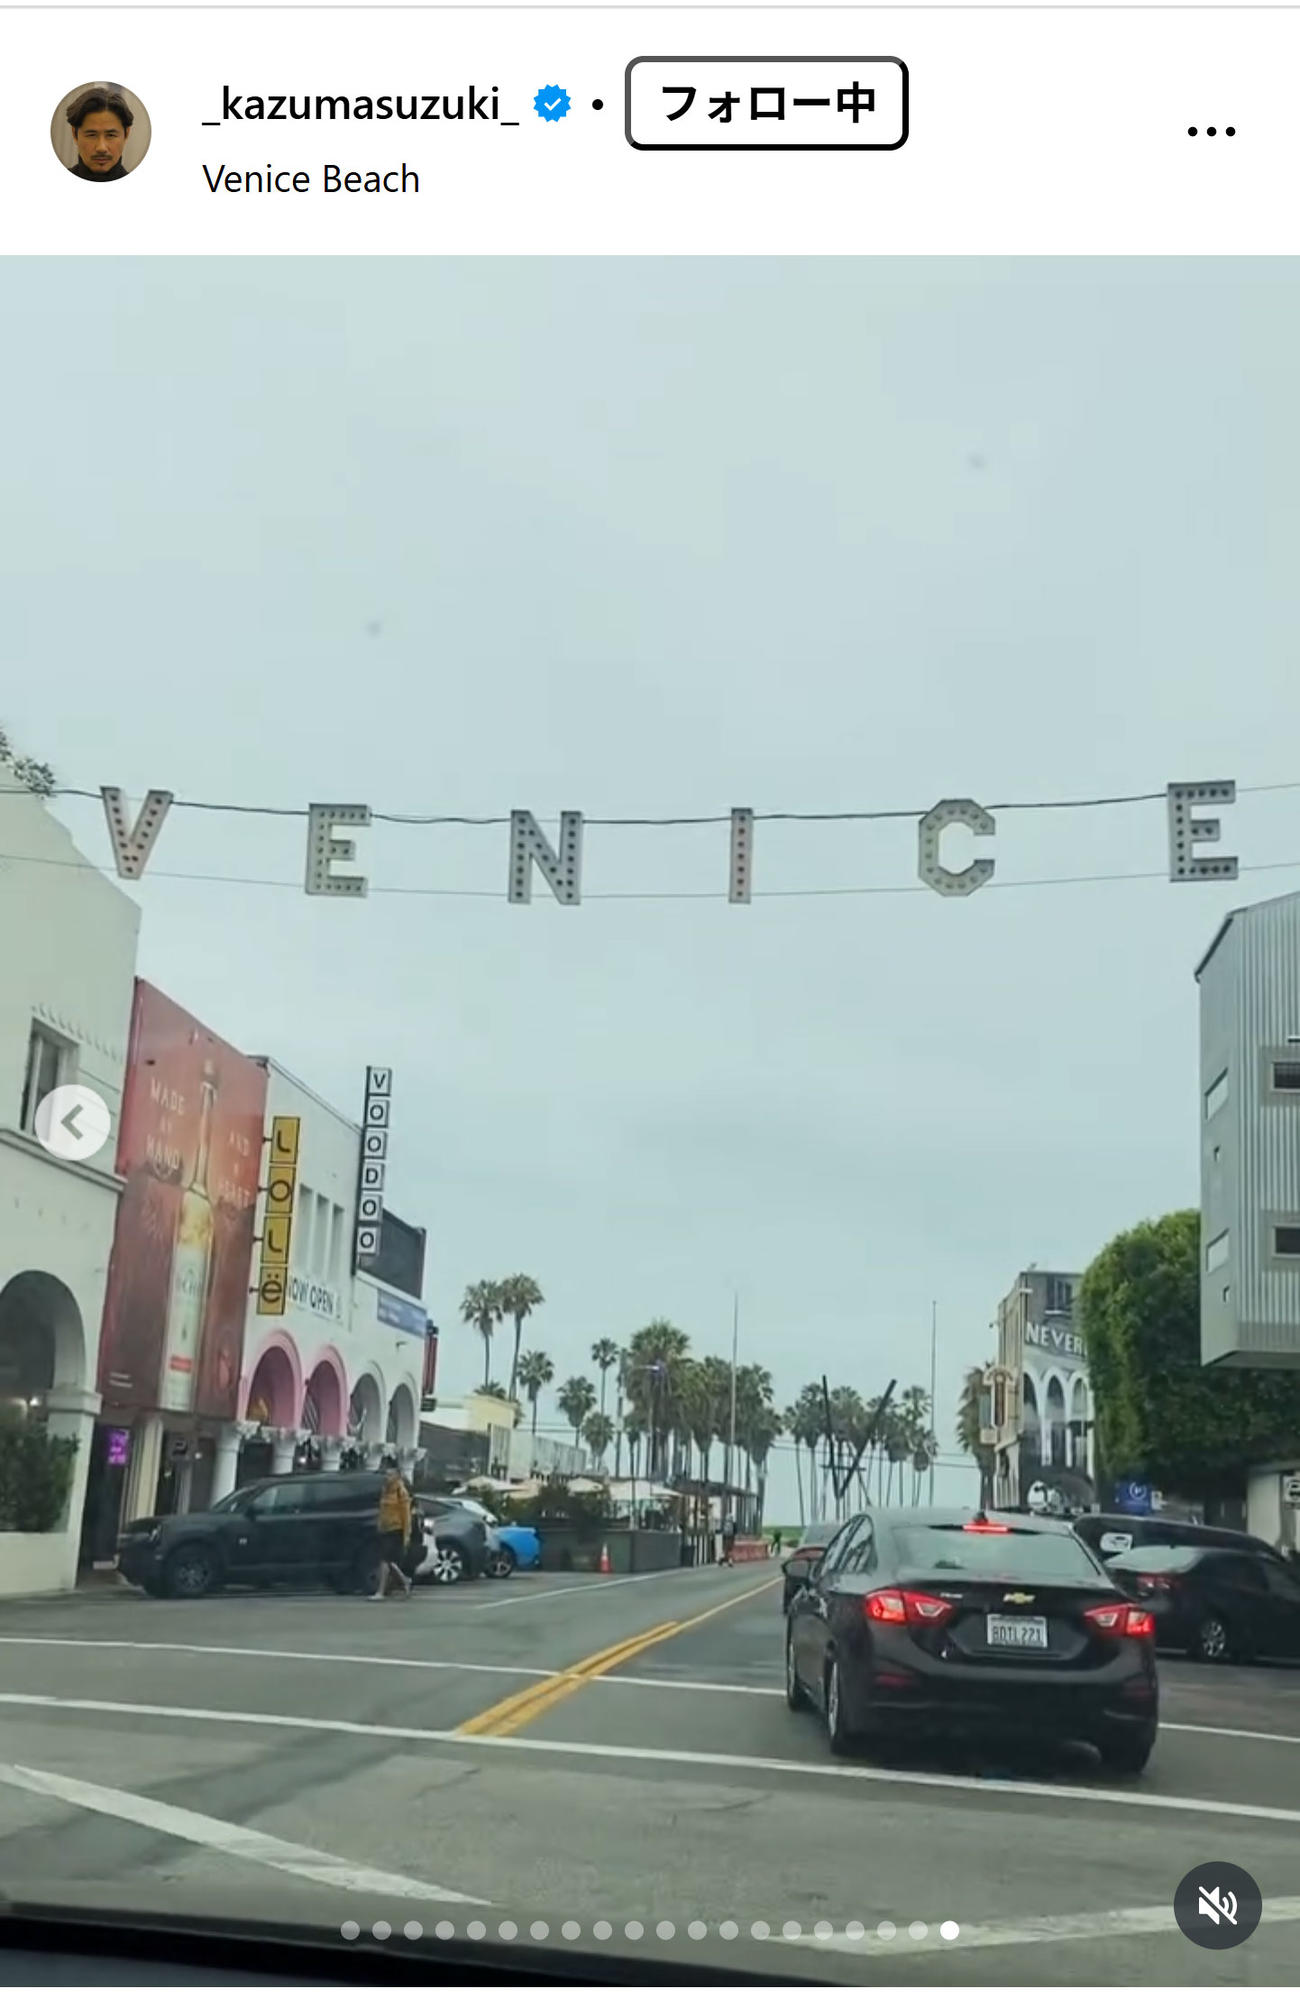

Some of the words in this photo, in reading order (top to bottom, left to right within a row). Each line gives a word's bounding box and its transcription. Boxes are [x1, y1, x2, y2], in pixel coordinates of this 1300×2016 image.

[99, 780, 1239, 906] VENICE
[151, 1077, 185, 1116] MADE
[360, 1073, 386, 1248] VOODOO
